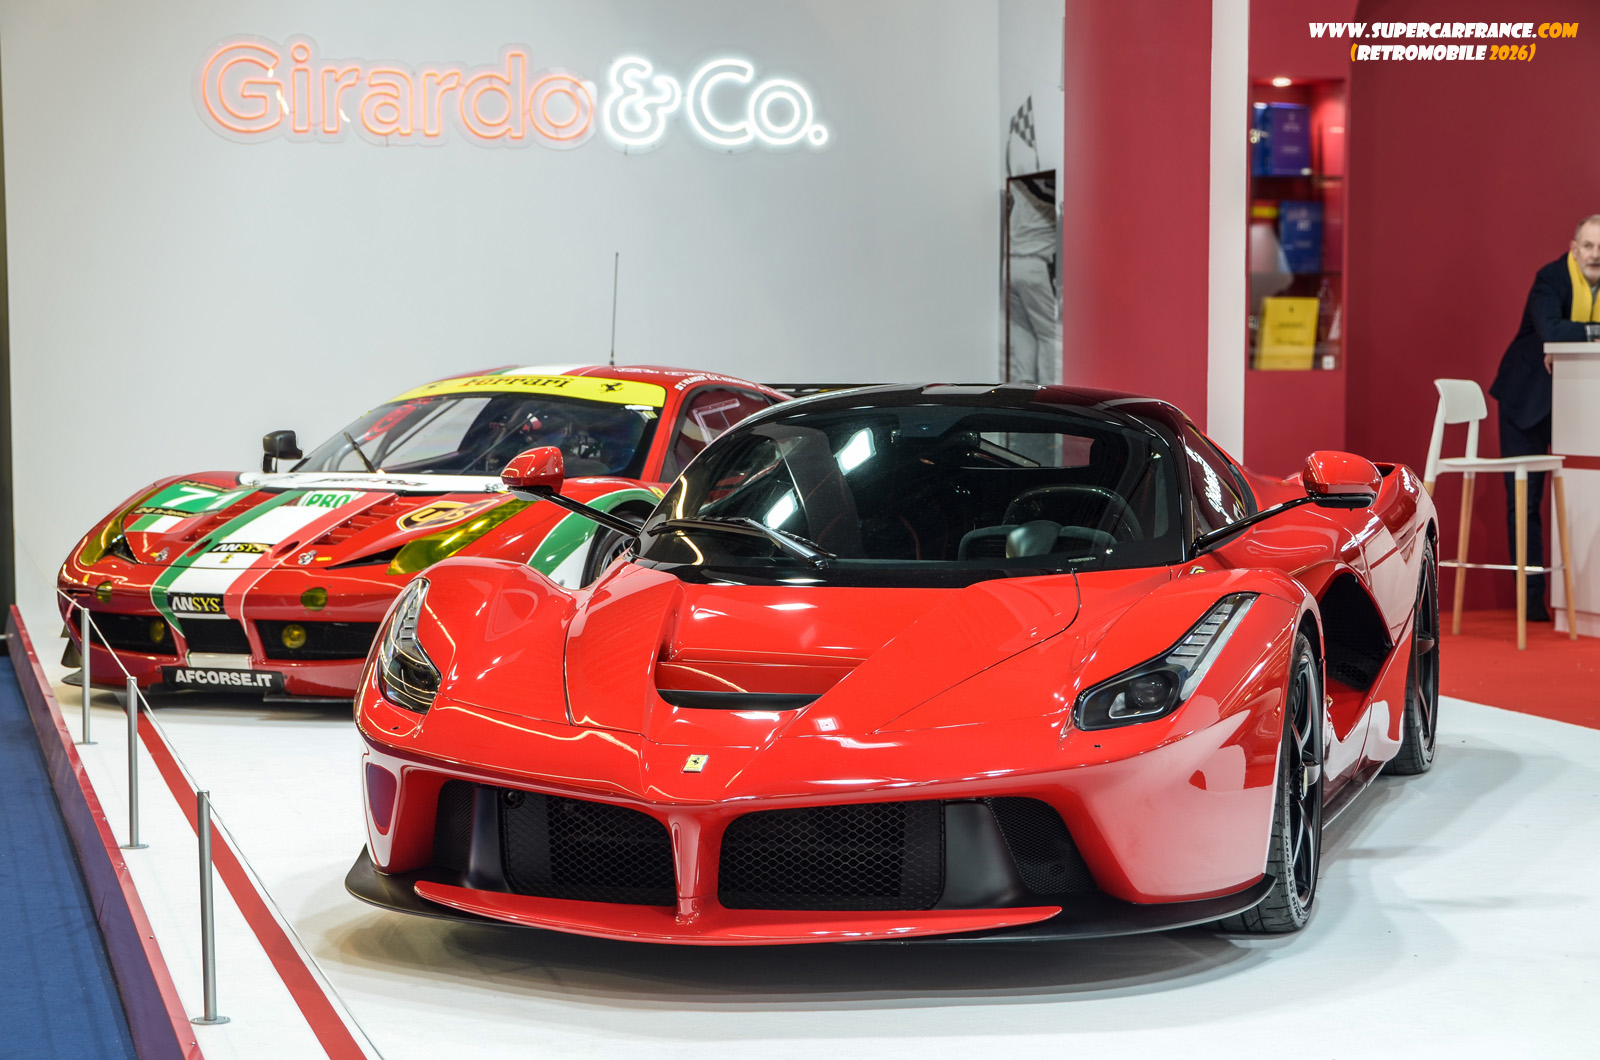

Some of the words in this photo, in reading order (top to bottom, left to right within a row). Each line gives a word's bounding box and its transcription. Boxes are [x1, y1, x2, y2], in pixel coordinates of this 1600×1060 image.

[460, 377, 573, 388] Ferrari
[160, 486, 245, 511] 71
[306, 493, 351, 508] PRO
[212, 542, 263, 553] ANSYS
[172, 596, 221, 612] ANSYS
[175, 669, 273, 687] AFCORSE.IT
